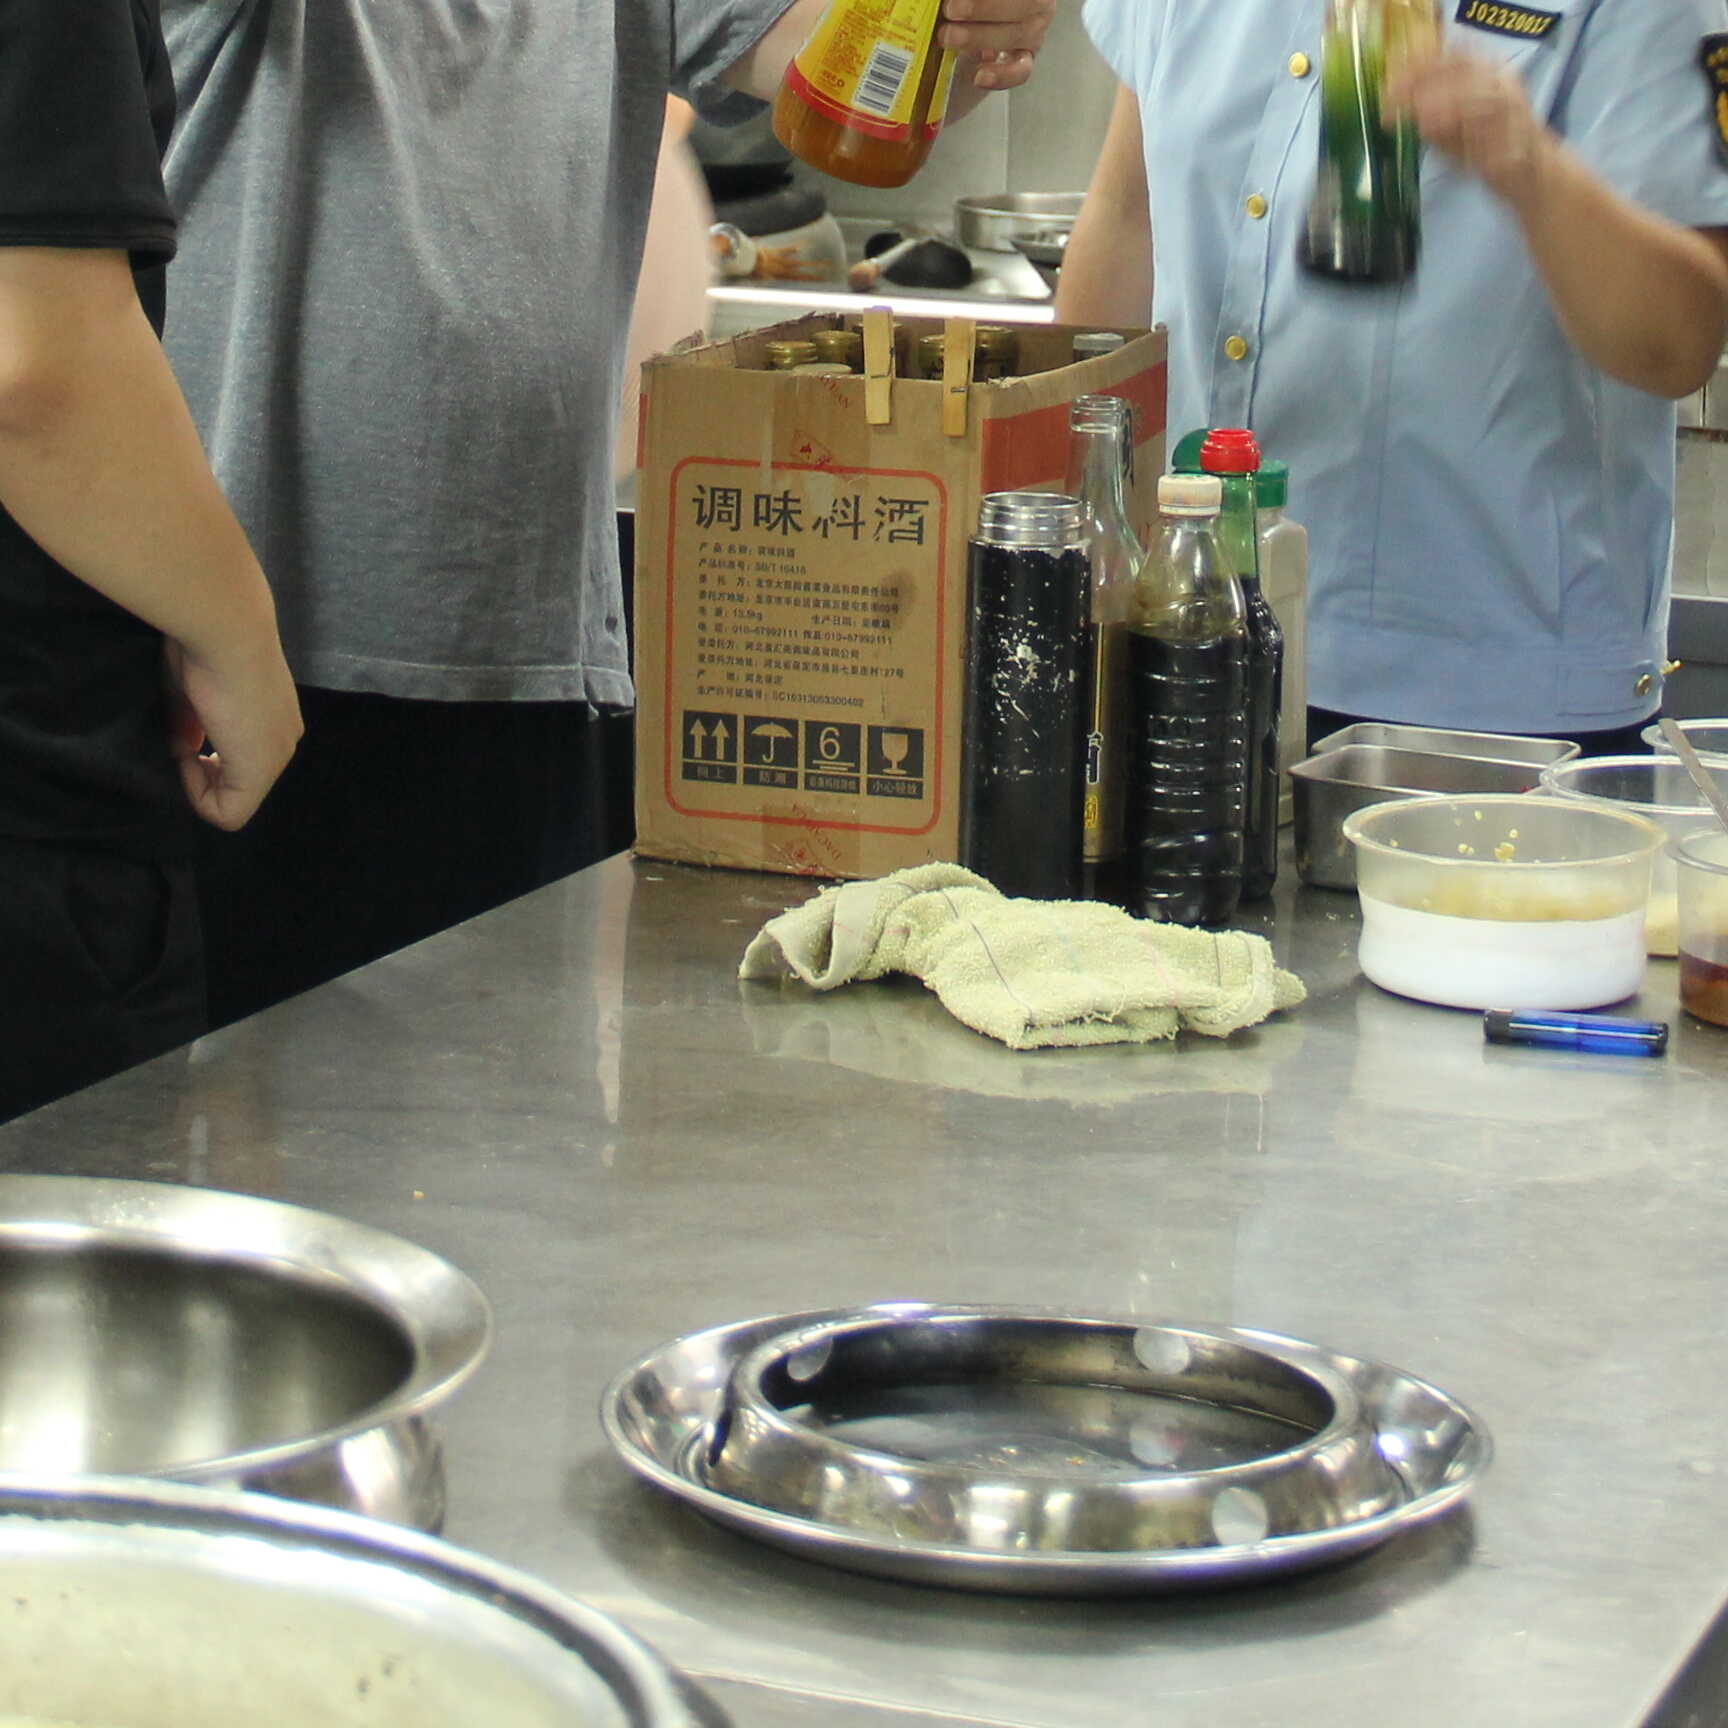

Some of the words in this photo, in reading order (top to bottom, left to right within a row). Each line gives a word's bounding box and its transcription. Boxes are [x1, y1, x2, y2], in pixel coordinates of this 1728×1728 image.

[692, 484, 929, 546] 调味料酒
[819, 726, 841, 760] 6
